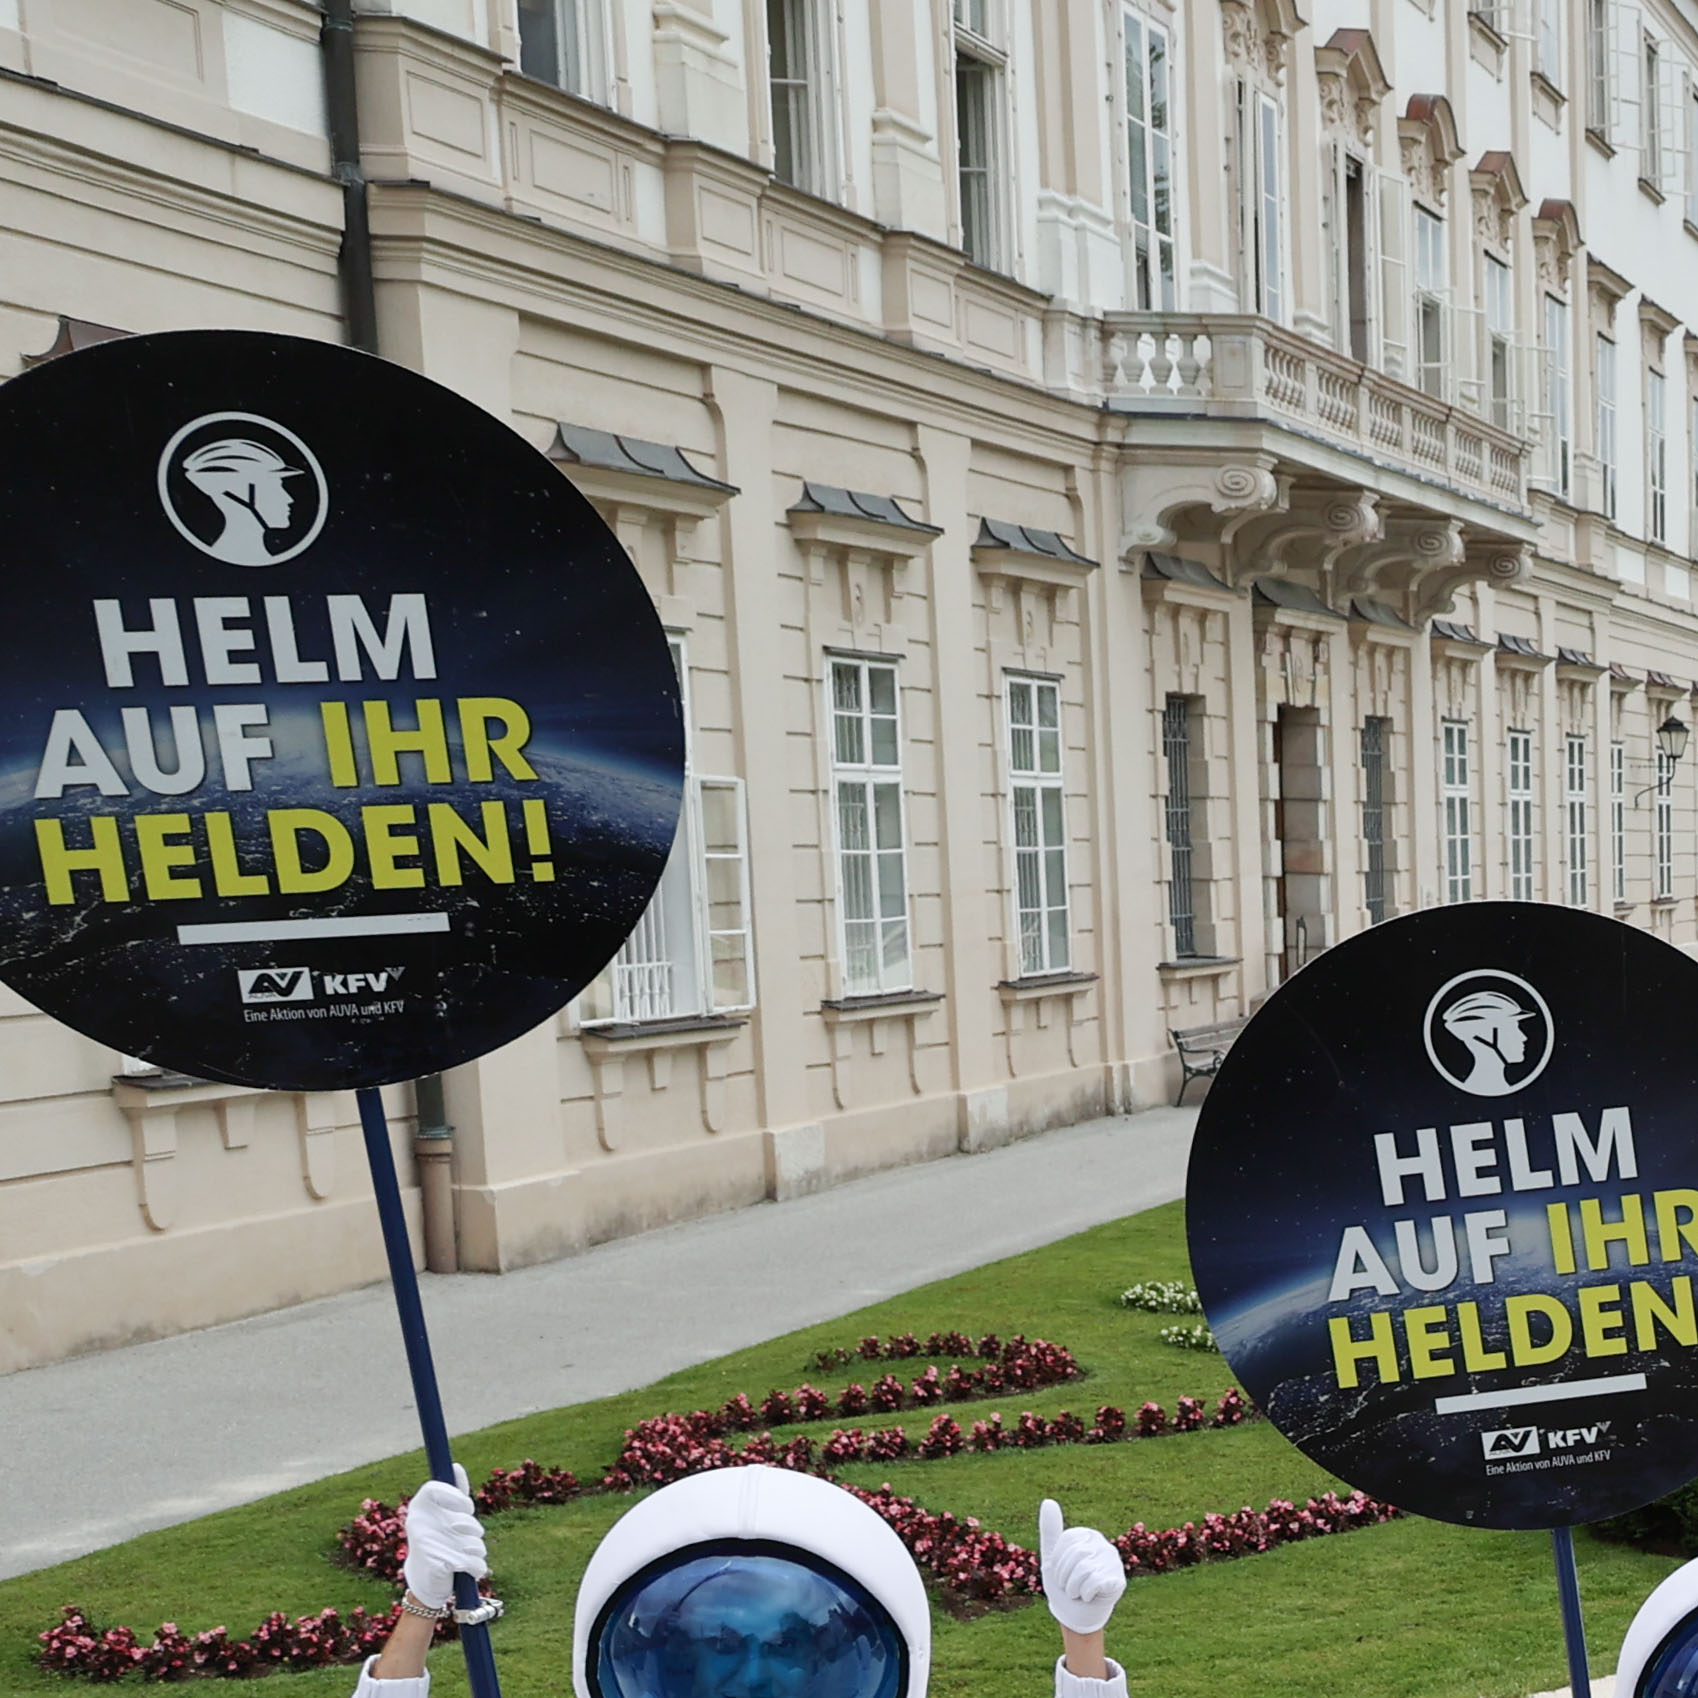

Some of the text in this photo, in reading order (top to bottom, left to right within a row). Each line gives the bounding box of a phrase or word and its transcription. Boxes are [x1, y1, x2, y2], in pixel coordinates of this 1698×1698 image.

[93, 593, 437, 688] HELM
[33, 697, 540, 798] AUF IHR
[33, 798, 555, 905] HELDEN!
[244, 1000, 404, 1022] Eine Aktion von AUVA und KFV
[323, 972, 388, 995] KFV
[1374, 1106, 1638, 1206] HELM
[1328, 1208, 1510, 1302] AUF
[1486, 1449, 1611, 1476] Eine Aktion von AUVA und KFV
[1547, 1426, 1598, 1449] KFV
